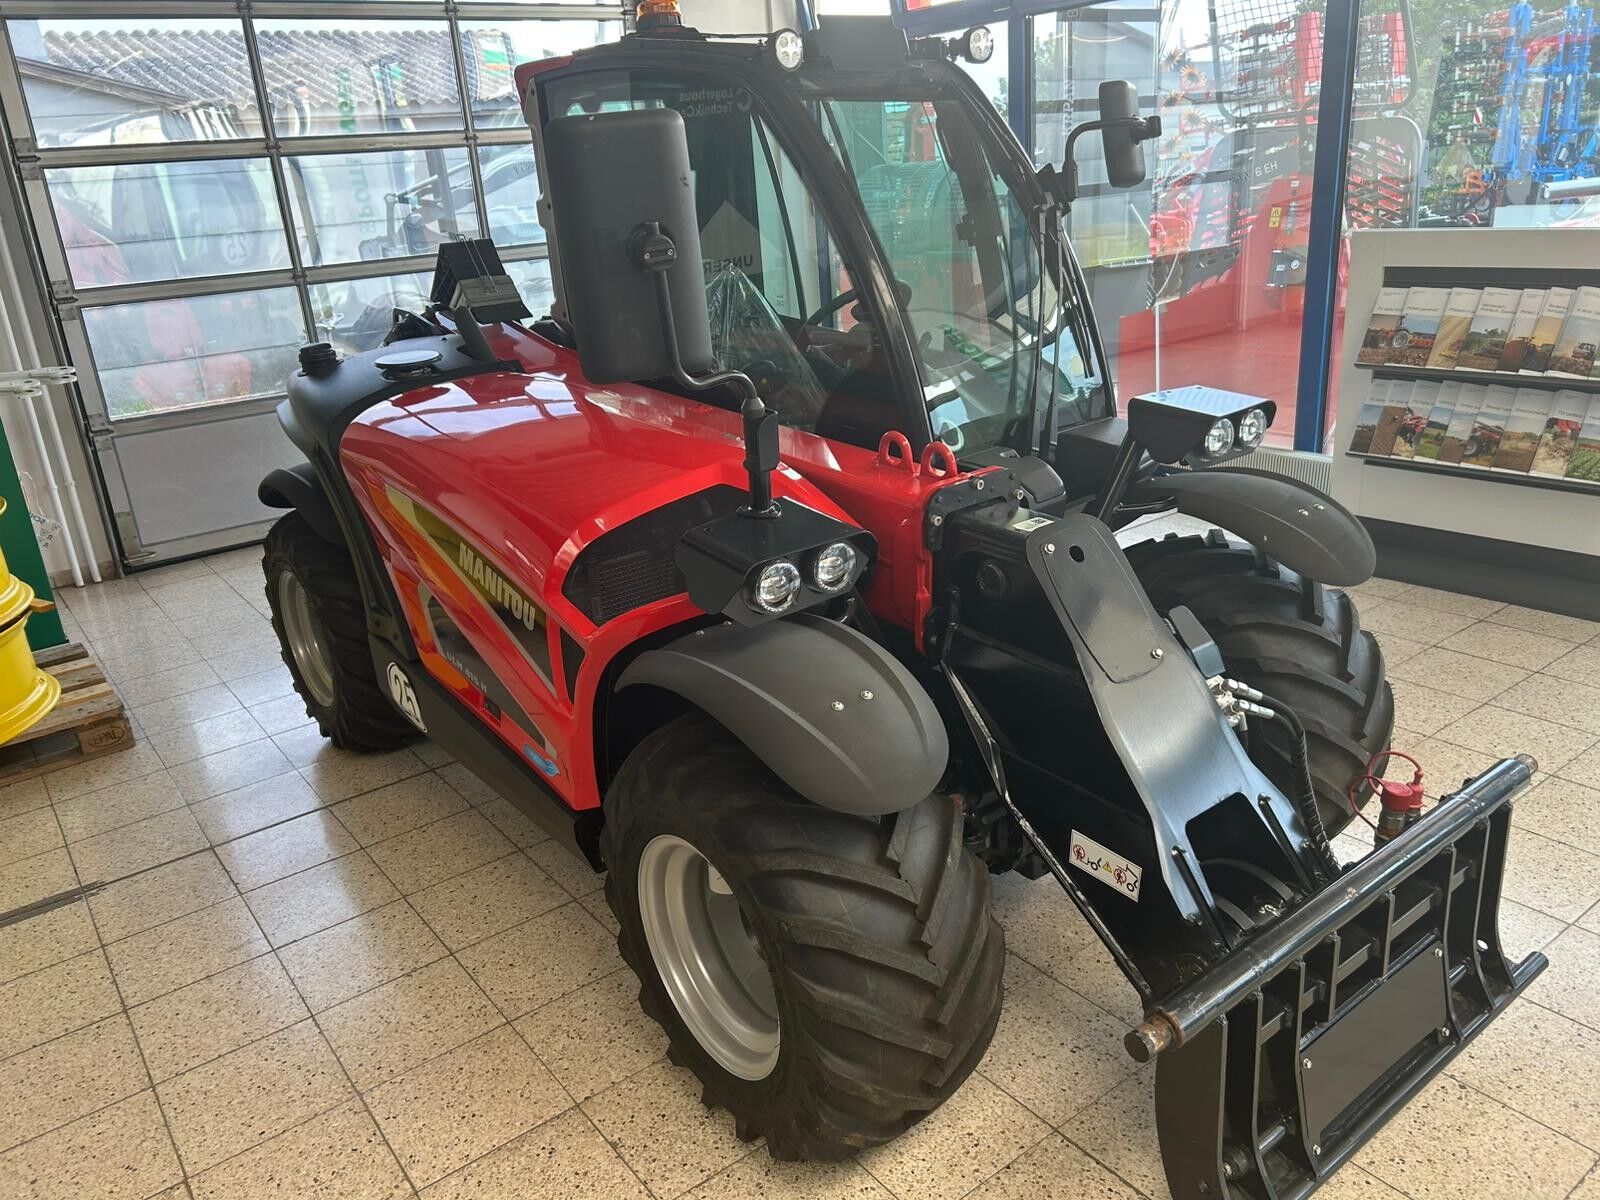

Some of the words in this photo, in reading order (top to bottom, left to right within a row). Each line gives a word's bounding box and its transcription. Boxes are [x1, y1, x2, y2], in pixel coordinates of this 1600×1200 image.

[1254, 166, 1263, 177] 6
[459, 541, 536, 631] MANITOU
[394, 673, 420, 722] 25
